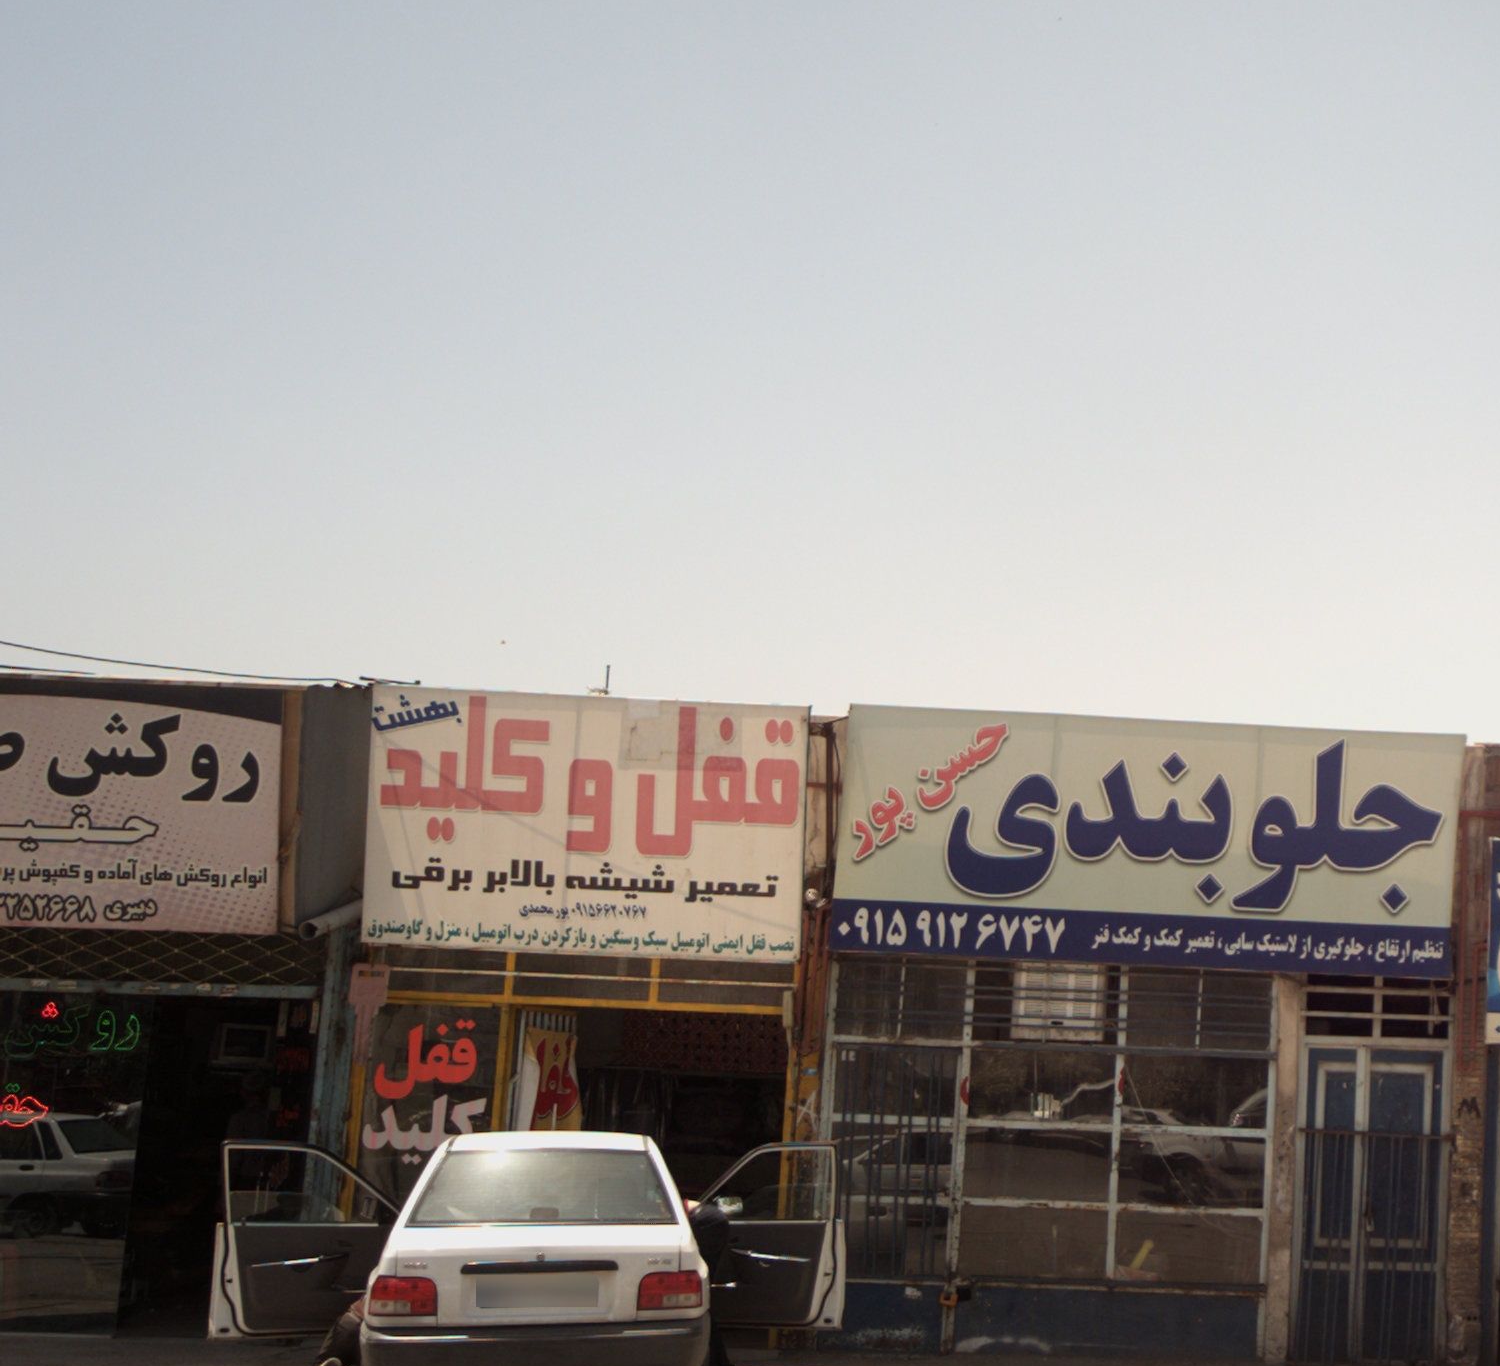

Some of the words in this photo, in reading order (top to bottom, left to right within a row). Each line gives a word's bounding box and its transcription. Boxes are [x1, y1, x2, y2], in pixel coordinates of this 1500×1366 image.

[372, 695, 463, 734] بهشت
[47, 713, 260, 802] روکش
[380, 696, 551, 843] کلید
[917, 721, 1010, 809] حسن
[635, 706, 801, 859] قفل
[566, 759, 614, 854] و
[852, 785, 917, 861] پور
[19, 859, 81, 886] کفپوش
[84, 869, 93, 884] و
[98, 858, 137, 881] آماده
[177, 865, 227, 887] روکش
[231, 867, 268, 889] انواع
[391, 857, 474, 893] برقی
[482, 859, 556, 896] بالابر
[566, 862, 675, 900] شیشه
[684, 875, 779, 904] تعمیر
[514, 928, 539, 946] درب
[642, 930, 668, 951] سبک
[837, 906, 907, 947] ۰۹۱۵
[916, 909, 968, 949] ۹۱۲
[974, 913, 1066, 954] ۶۷۴۷
[1091, 924, 1110, 950] فنر
[1112, 925, 1142, 946] کمک
[1153, 928, 1183, 948] کمک
[1184, 930, 1215, 954] تعمیر
[712, 935, 743, 953] ایمنی
[746, 933, 766, 955] قفل
[769, 940, 795, 956] نصب
[1143, 934, 1151, 952] و
[1256, 933, 1298, 957] لاستیک
[1299, 935, 1312, 960] از
[1313, 937, 1365, 961] جلوگیری
[1375, 938, 1411, 964] ارتفاع
[1411, 939, 1445, 963] تنظیم
[374, 1019, 479, 1100] قفل
